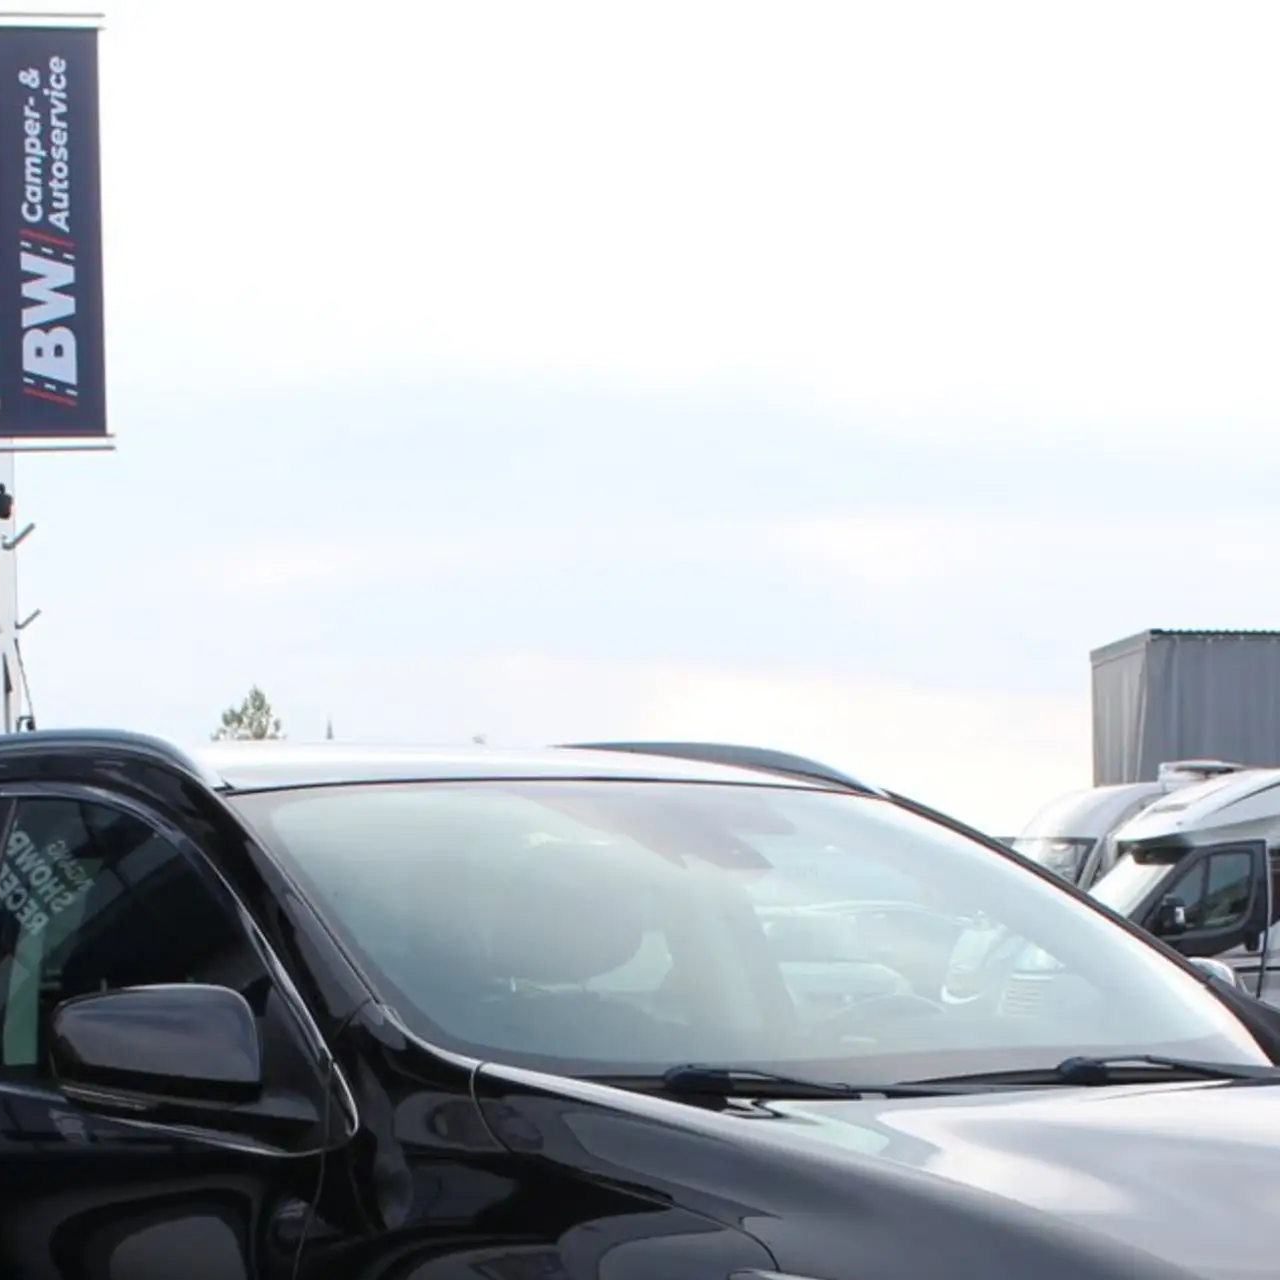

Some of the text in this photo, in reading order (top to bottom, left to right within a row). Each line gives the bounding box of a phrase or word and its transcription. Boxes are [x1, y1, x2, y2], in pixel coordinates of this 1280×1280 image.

[19, 67, 47, 223] Camper- &
[42, 55, 69, 233] Autoservice
[20, 251, 78, 385] BW
